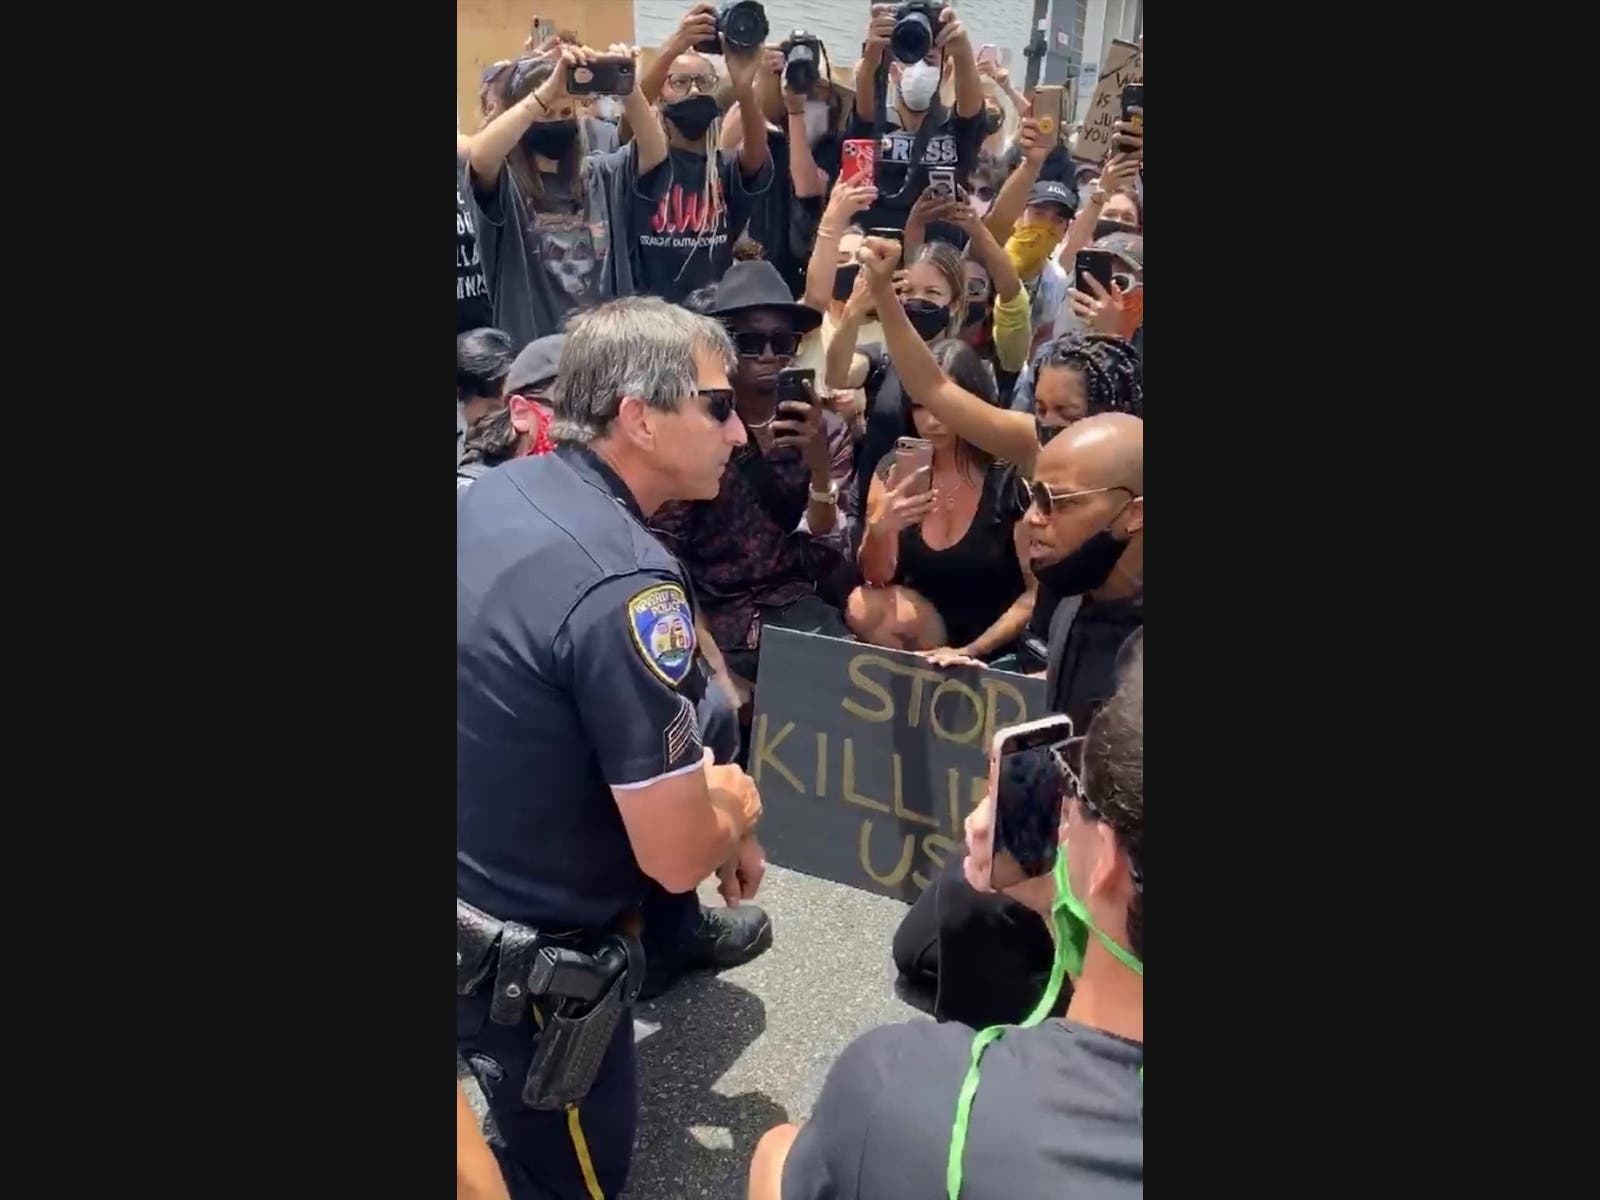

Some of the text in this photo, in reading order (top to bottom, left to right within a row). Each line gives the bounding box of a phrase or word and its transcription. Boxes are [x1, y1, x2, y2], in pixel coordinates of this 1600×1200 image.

[881, 137, 957, 162] PRSS
[1083, 126, 1110, 145] YOU
[841, 653, 1027, 752] STOP
[858, 818, 960, 890] US
